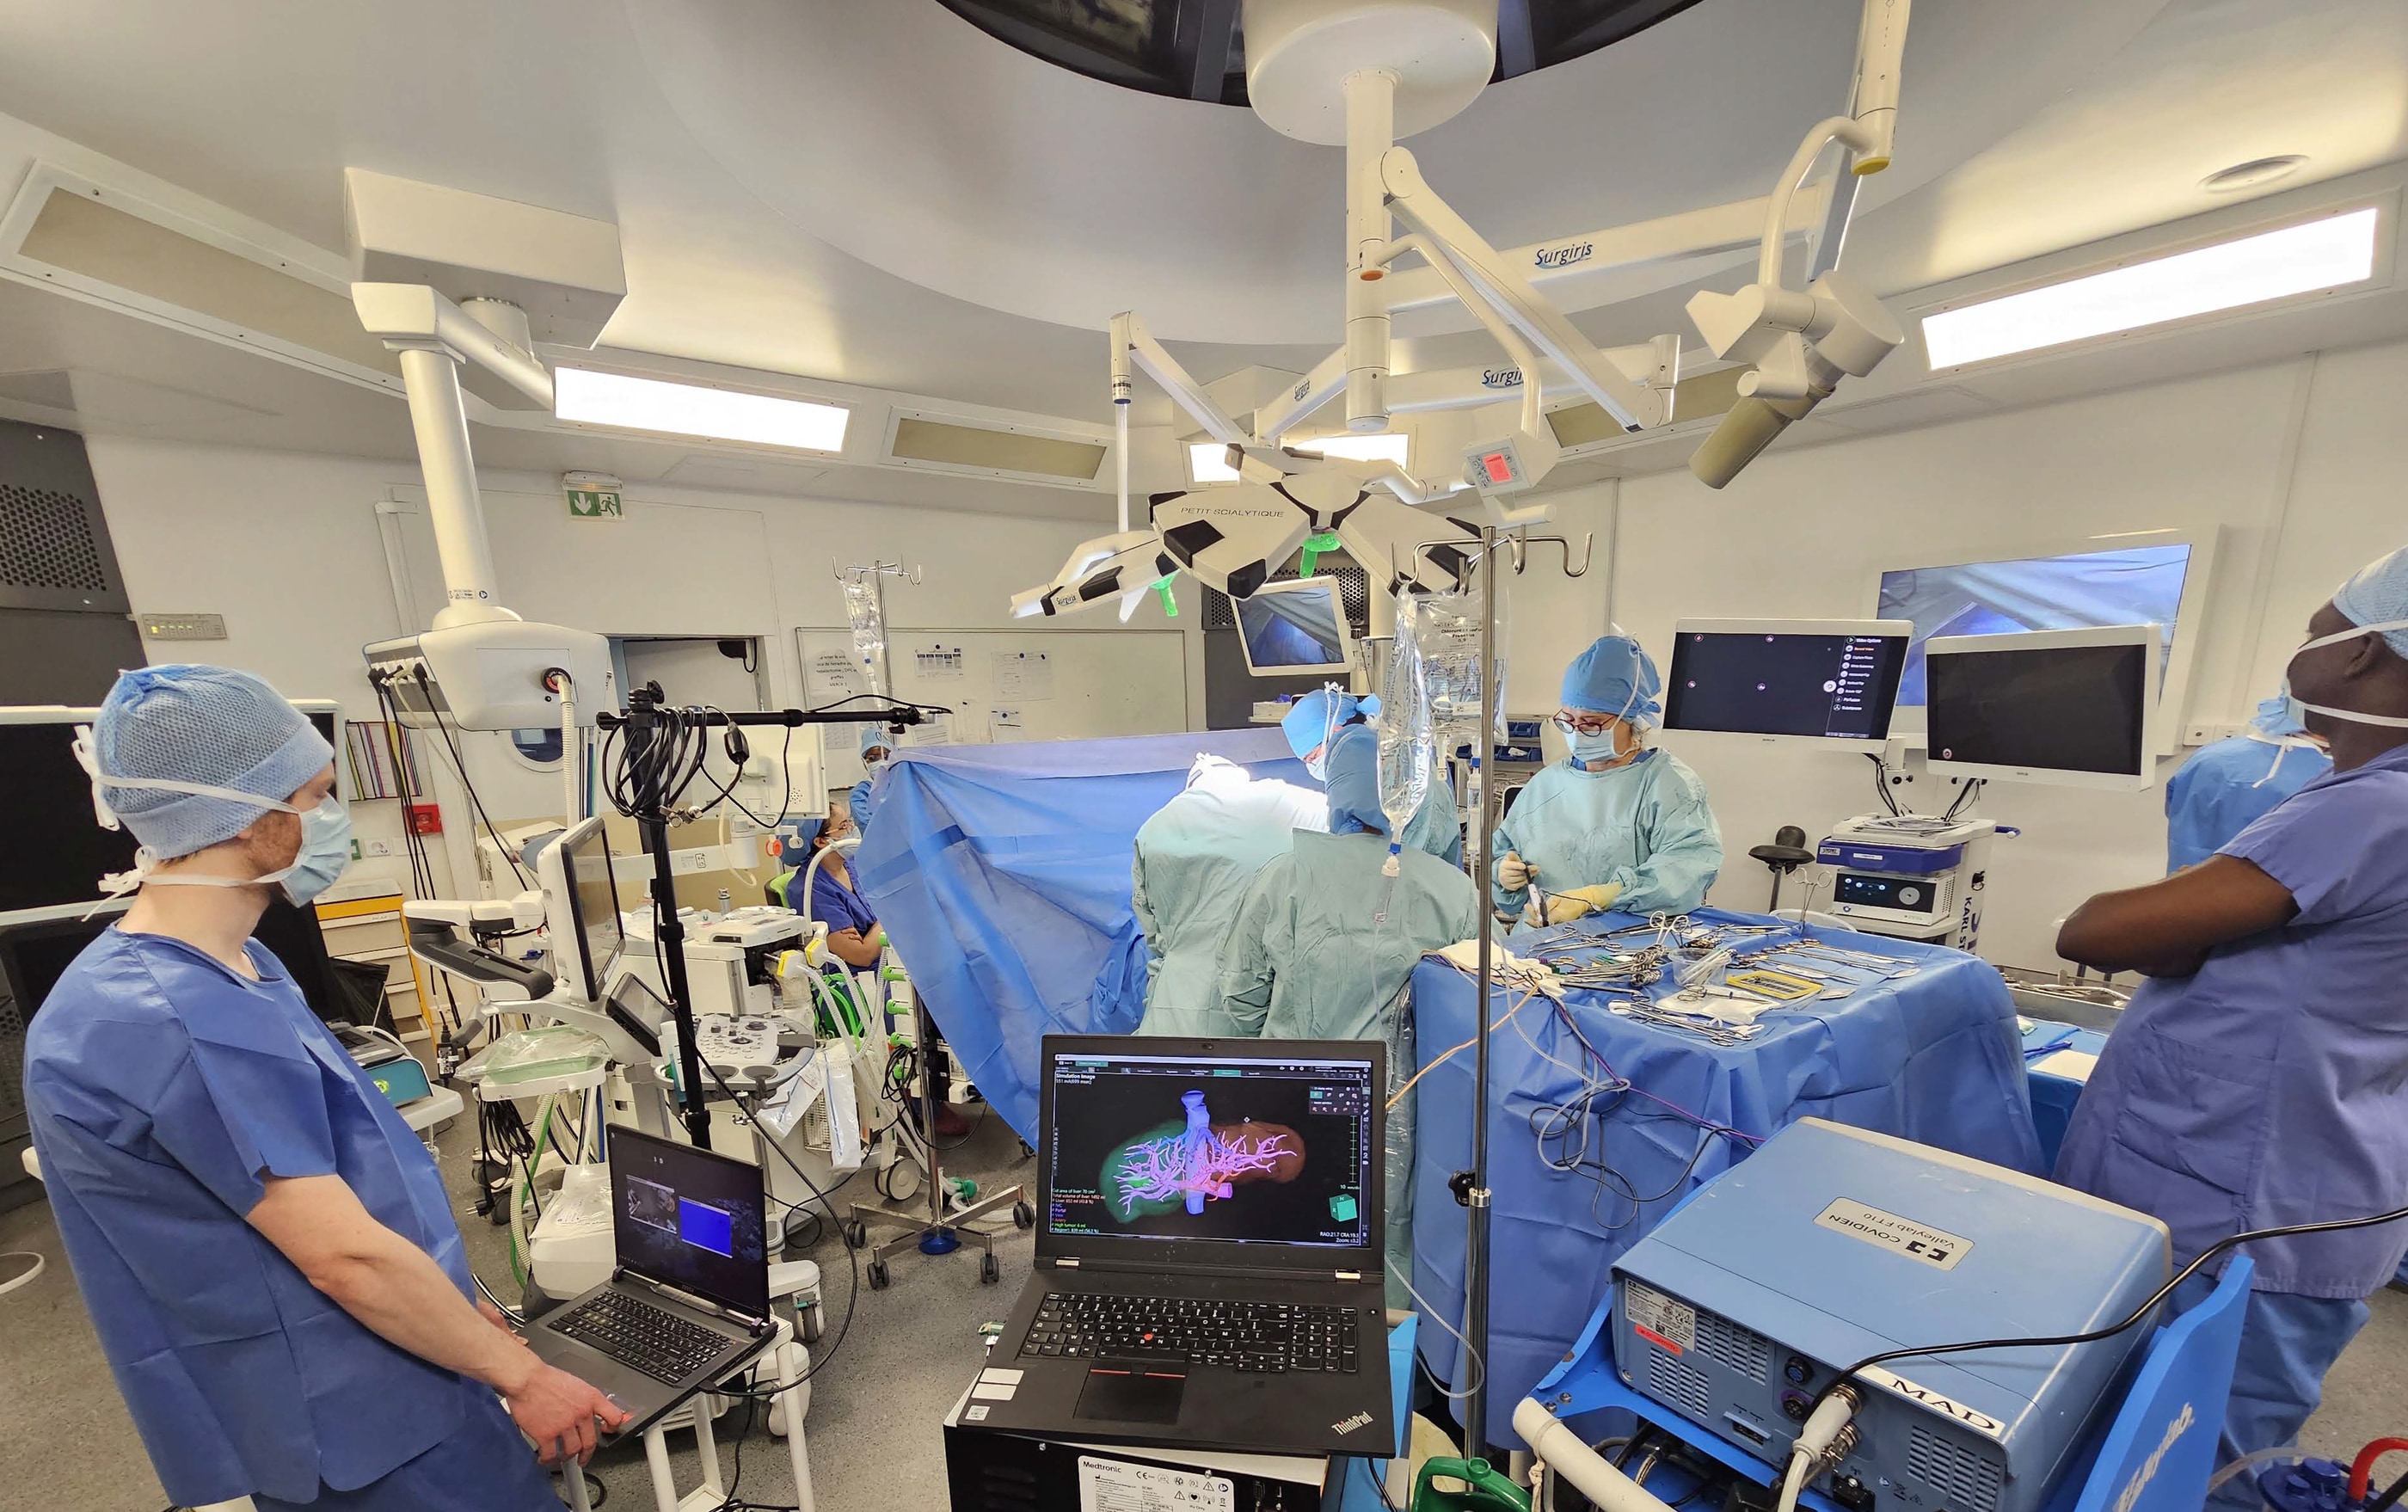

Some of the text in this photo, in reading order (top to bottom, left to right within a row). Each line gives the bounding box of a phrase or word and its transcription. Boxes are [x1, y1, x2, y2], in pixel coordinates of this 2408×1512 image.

[1534, 241, 1593, 265] Surgiris
[1482, 367, 1523, 386] Surgi
[1213, 508, 1284, 518] SCIALYTIQUE
[1961, 897, 1972, 933] KARL
[1828, 1214, 1901, 1244] COVIDIEN
[1863, 1213, 1955, 1250] Valleylab FT10
[1889, 1378, 1995, 1429] MAD
[1331, 1411, 1373, 1435] ThinkPad
[1083, 1460, 1121, 1473] Medtronic
